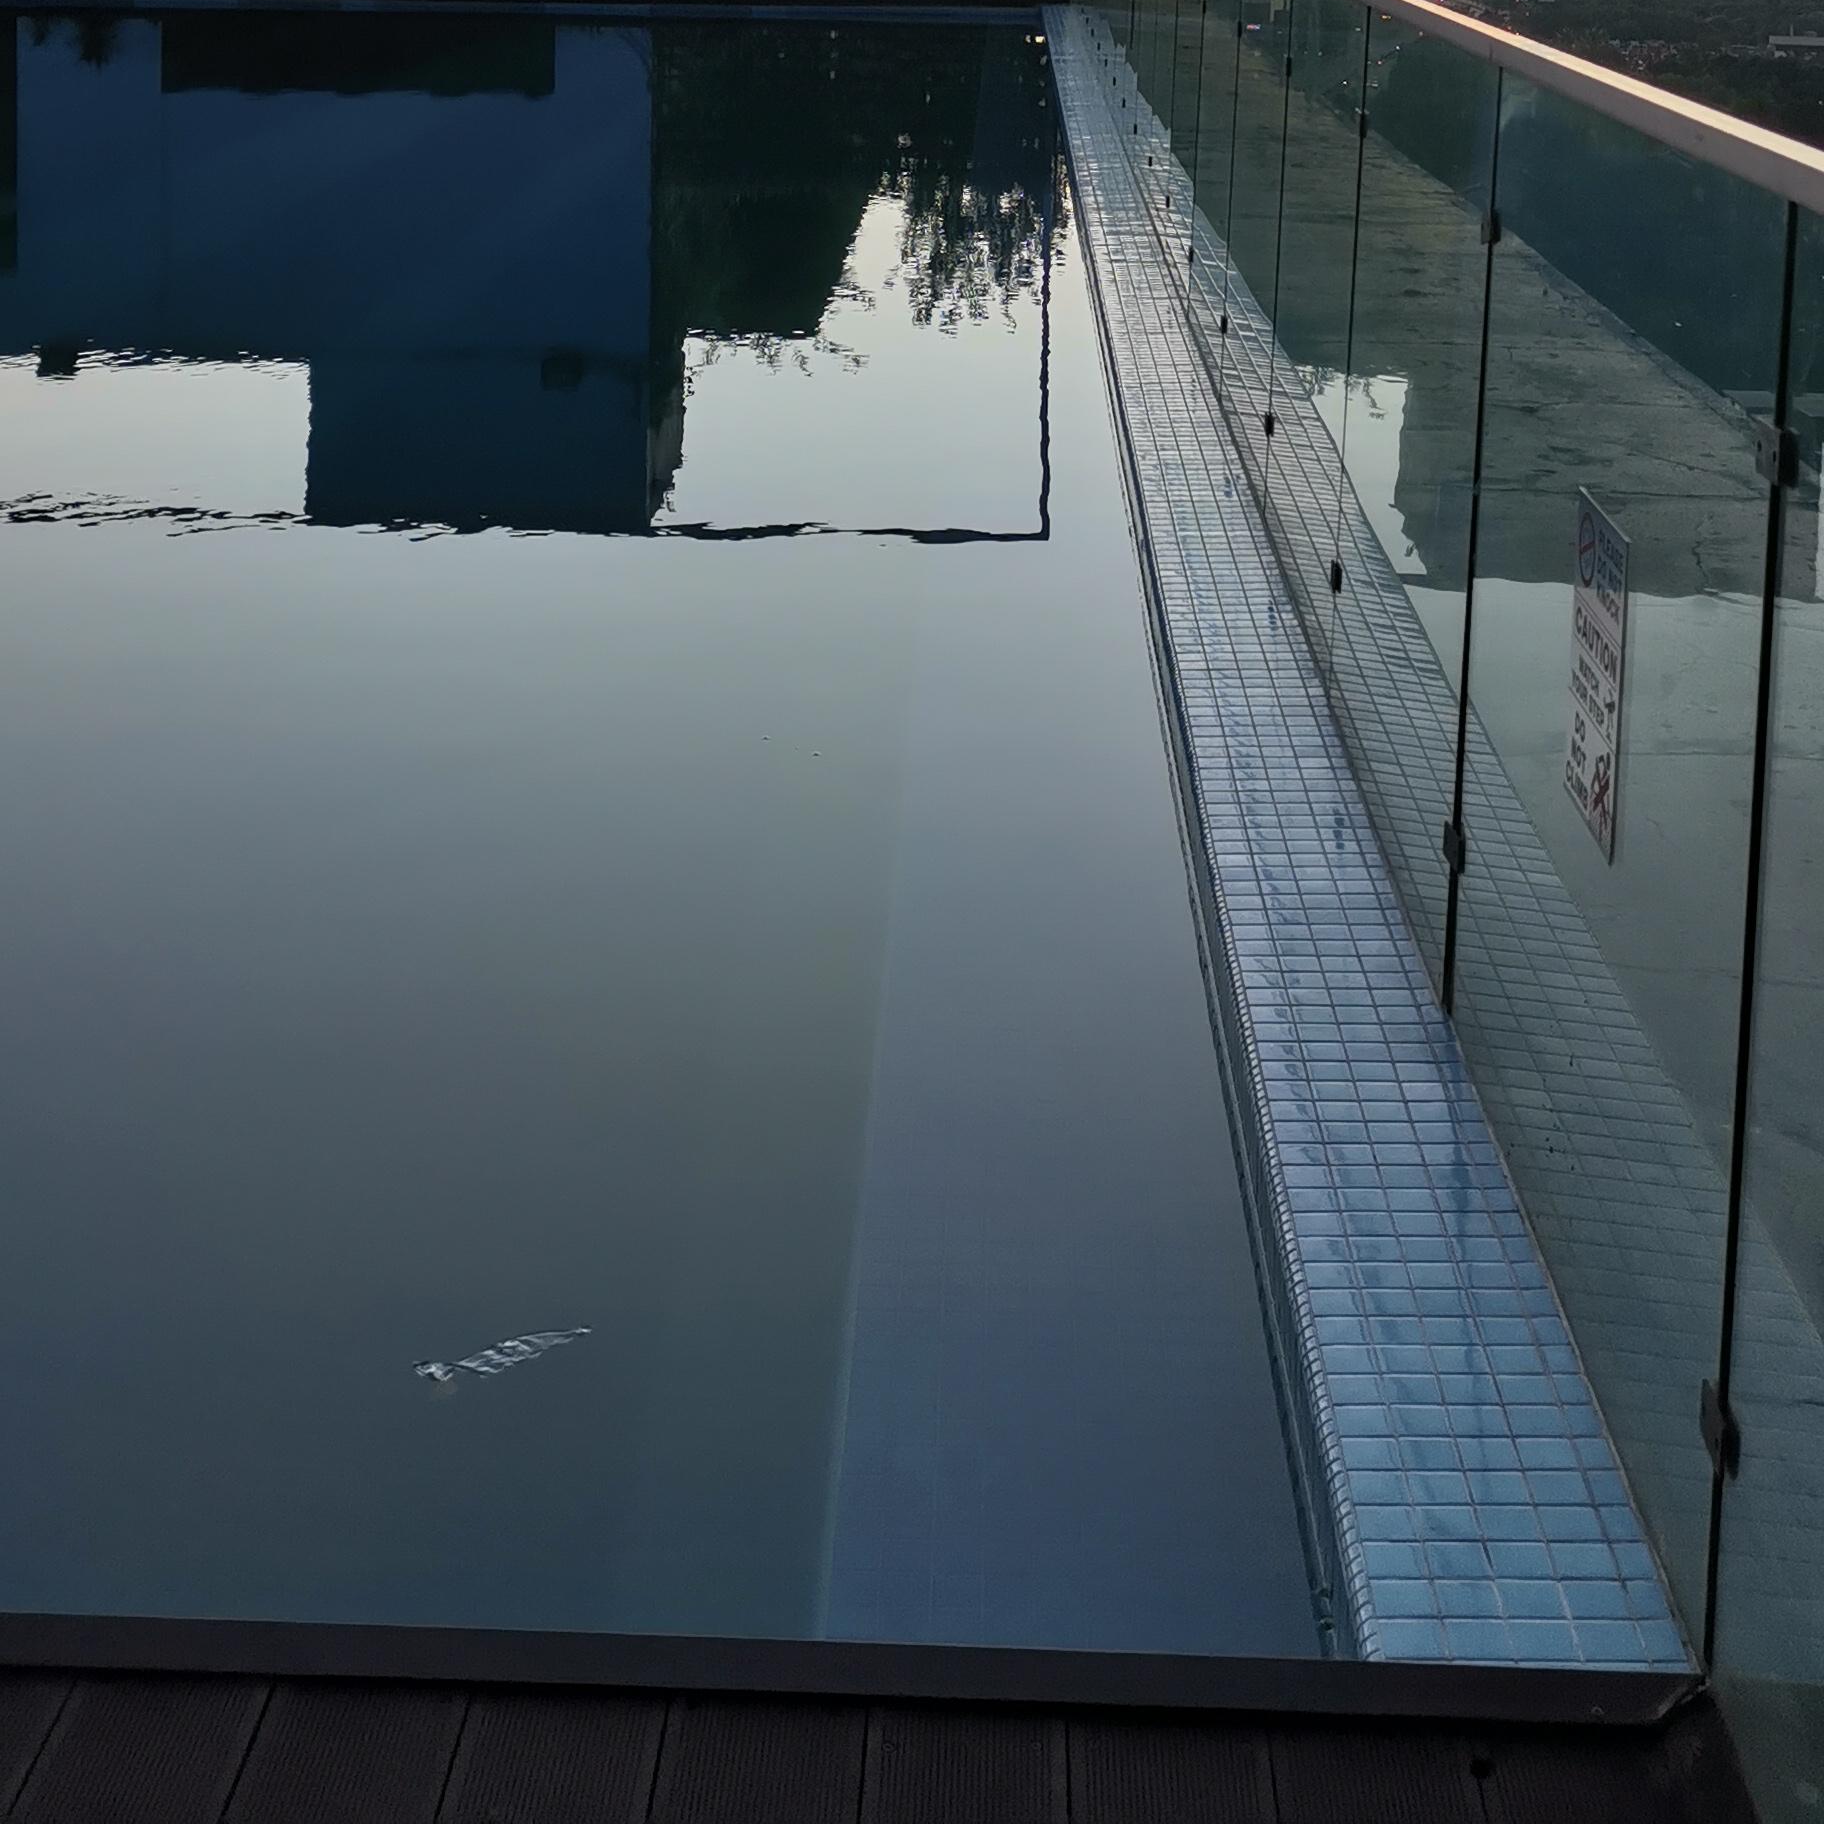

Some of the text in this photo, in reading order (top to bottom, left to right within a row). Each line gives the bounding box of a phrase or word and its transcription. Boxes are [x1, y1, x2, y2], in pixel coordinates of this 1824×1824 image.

[1576, 605, 1617, 685] CAUTION
[1575, 710, 1585, 743] DO
[1572, 736, 1586, 776] NOT
